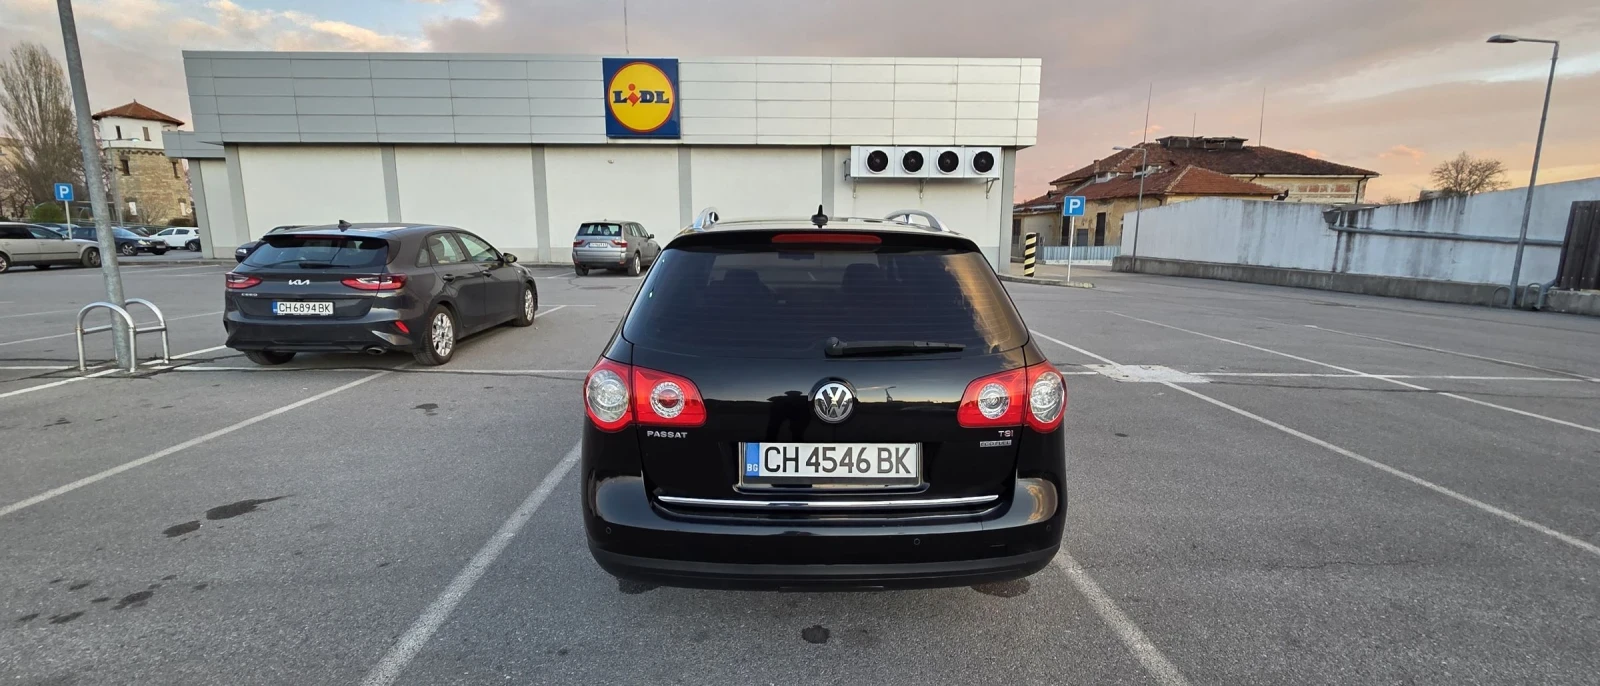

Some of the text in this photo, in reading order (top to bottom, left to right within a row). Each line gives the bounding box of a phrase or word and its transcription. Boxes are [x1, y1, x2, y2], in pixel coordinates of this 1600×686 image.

[60, 185, 69, 198] P
[1069, 199, 1080, 213] P
[293, 303, 317, 313] 6894
[647, 430, 688, 438] PASSAT
[764, 446, 911, 474] CH 4546 BK
[747, 464, 758, 472] BG
